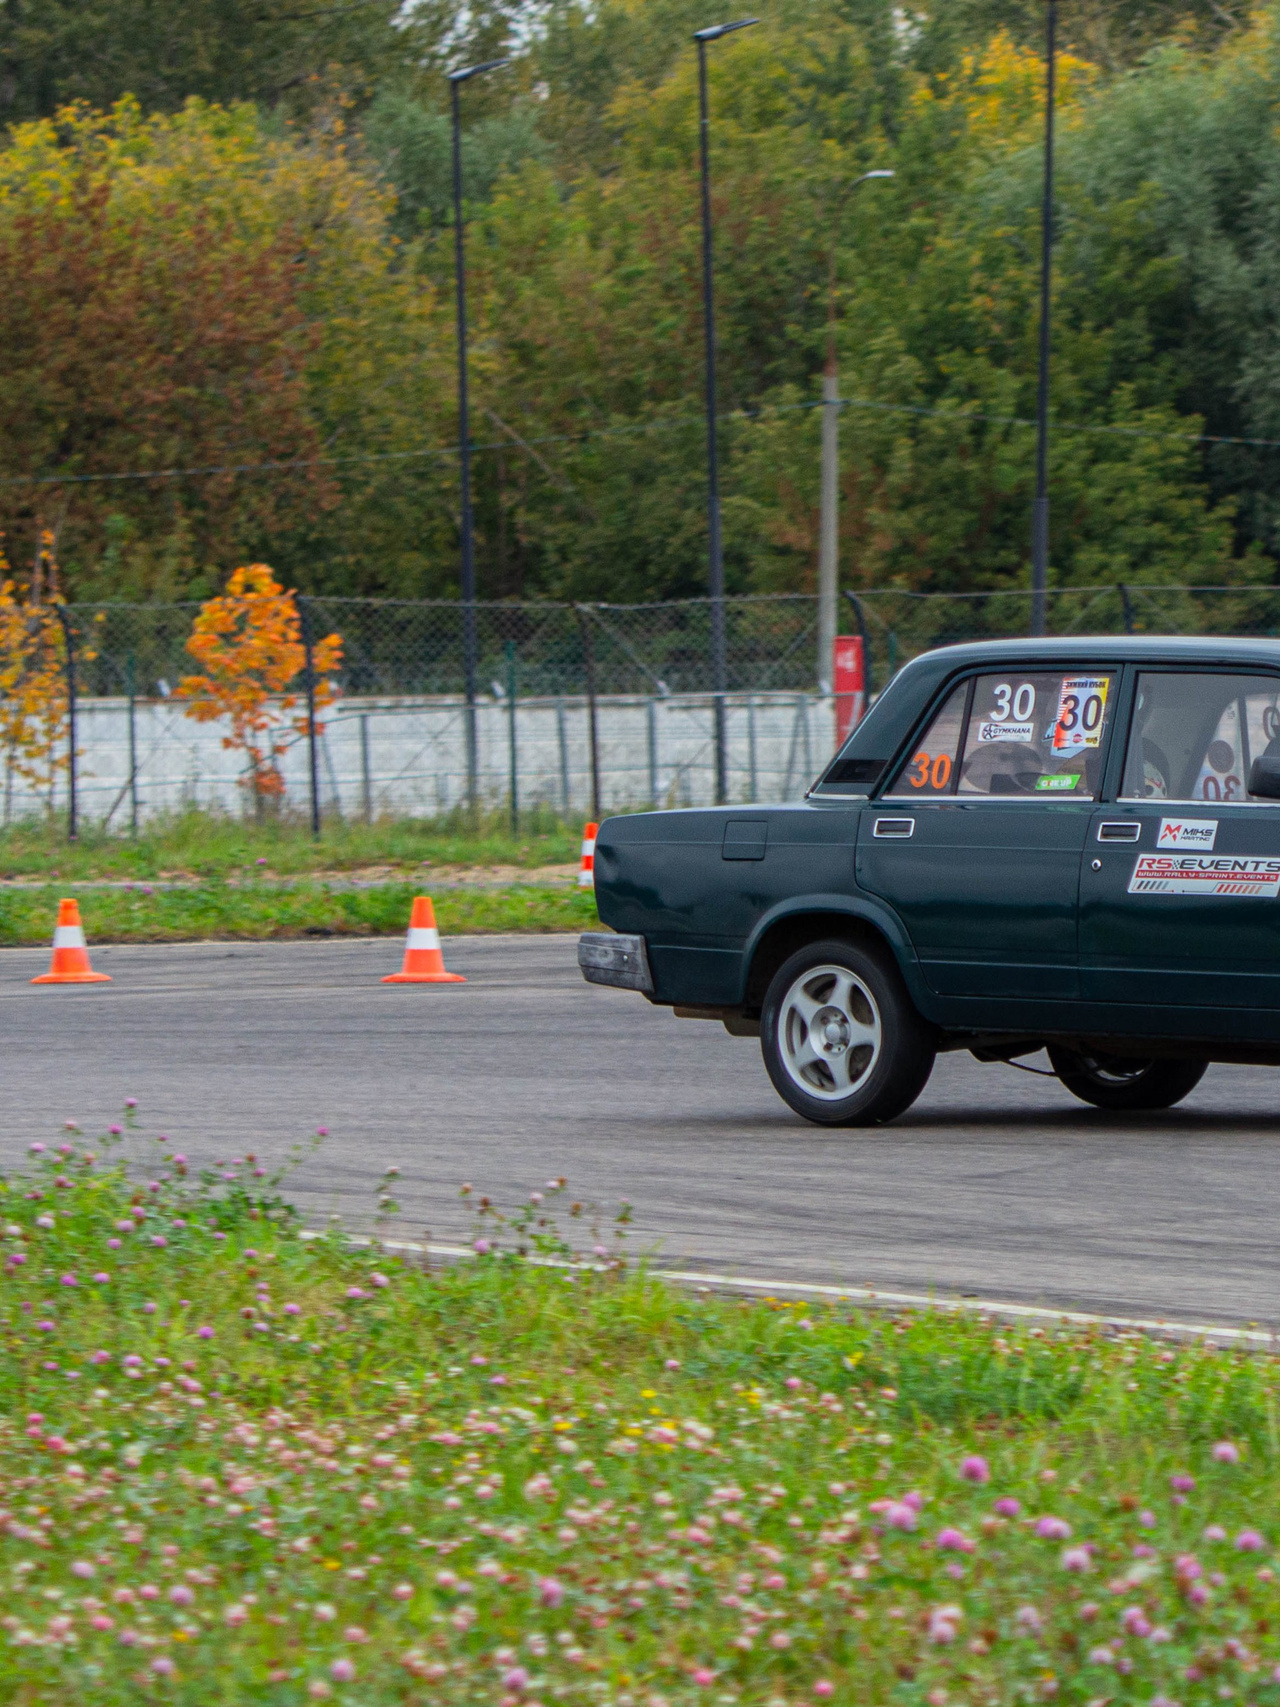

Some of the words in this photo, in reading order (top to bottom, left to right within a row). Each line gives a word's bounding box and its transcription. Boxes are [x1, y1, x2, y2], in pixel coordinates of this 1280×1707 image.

[989, 683, 1036, 721] 30
[1060, 695, 1102, 731] 30
[910, 752, 951, 789] 30
[1182, 828, 1214, 837] MIKS
